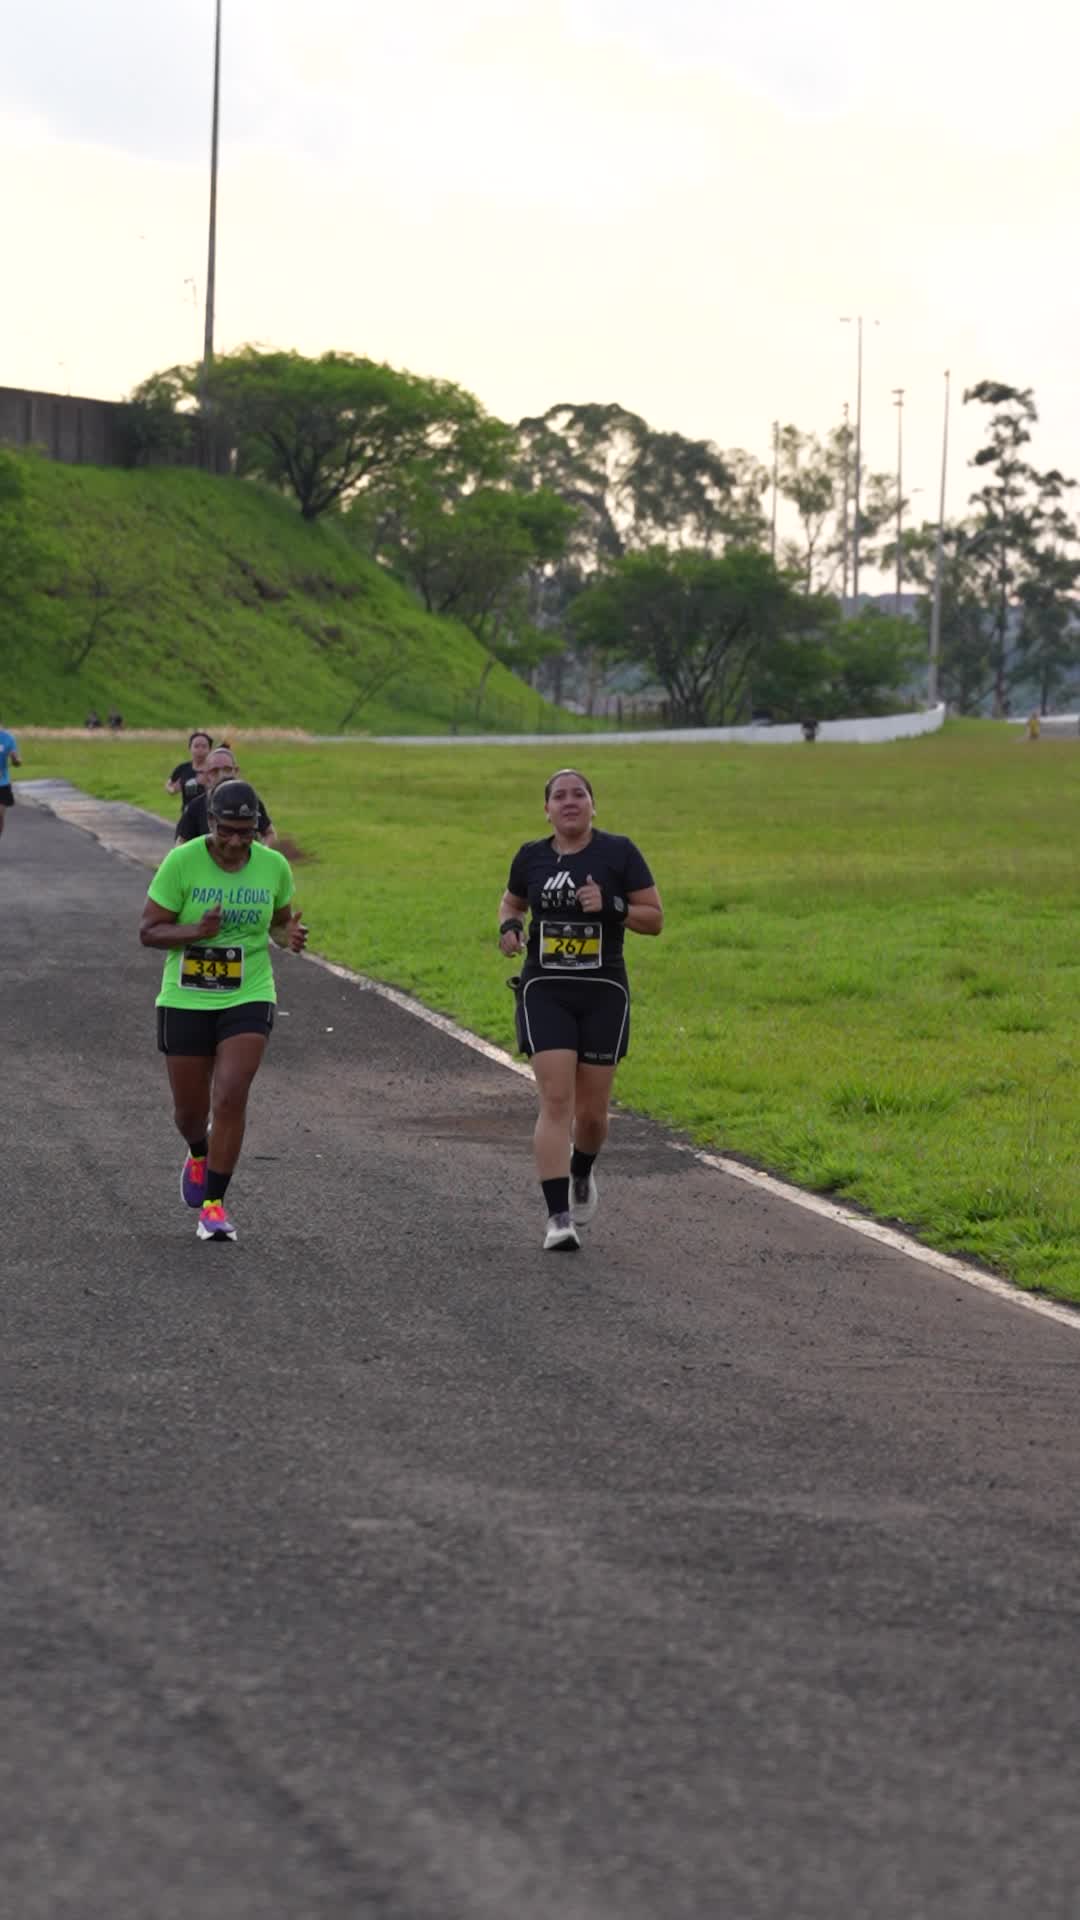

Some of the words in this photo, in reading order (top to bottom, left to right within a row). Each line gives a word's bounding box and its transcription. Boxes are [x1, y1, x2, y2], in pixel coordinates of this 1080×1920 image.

[192, 886, 270, 904] PAPA-LÉGUAS
[554, 938, 587, 955] 267
[195, 960, 229, 977] 343
